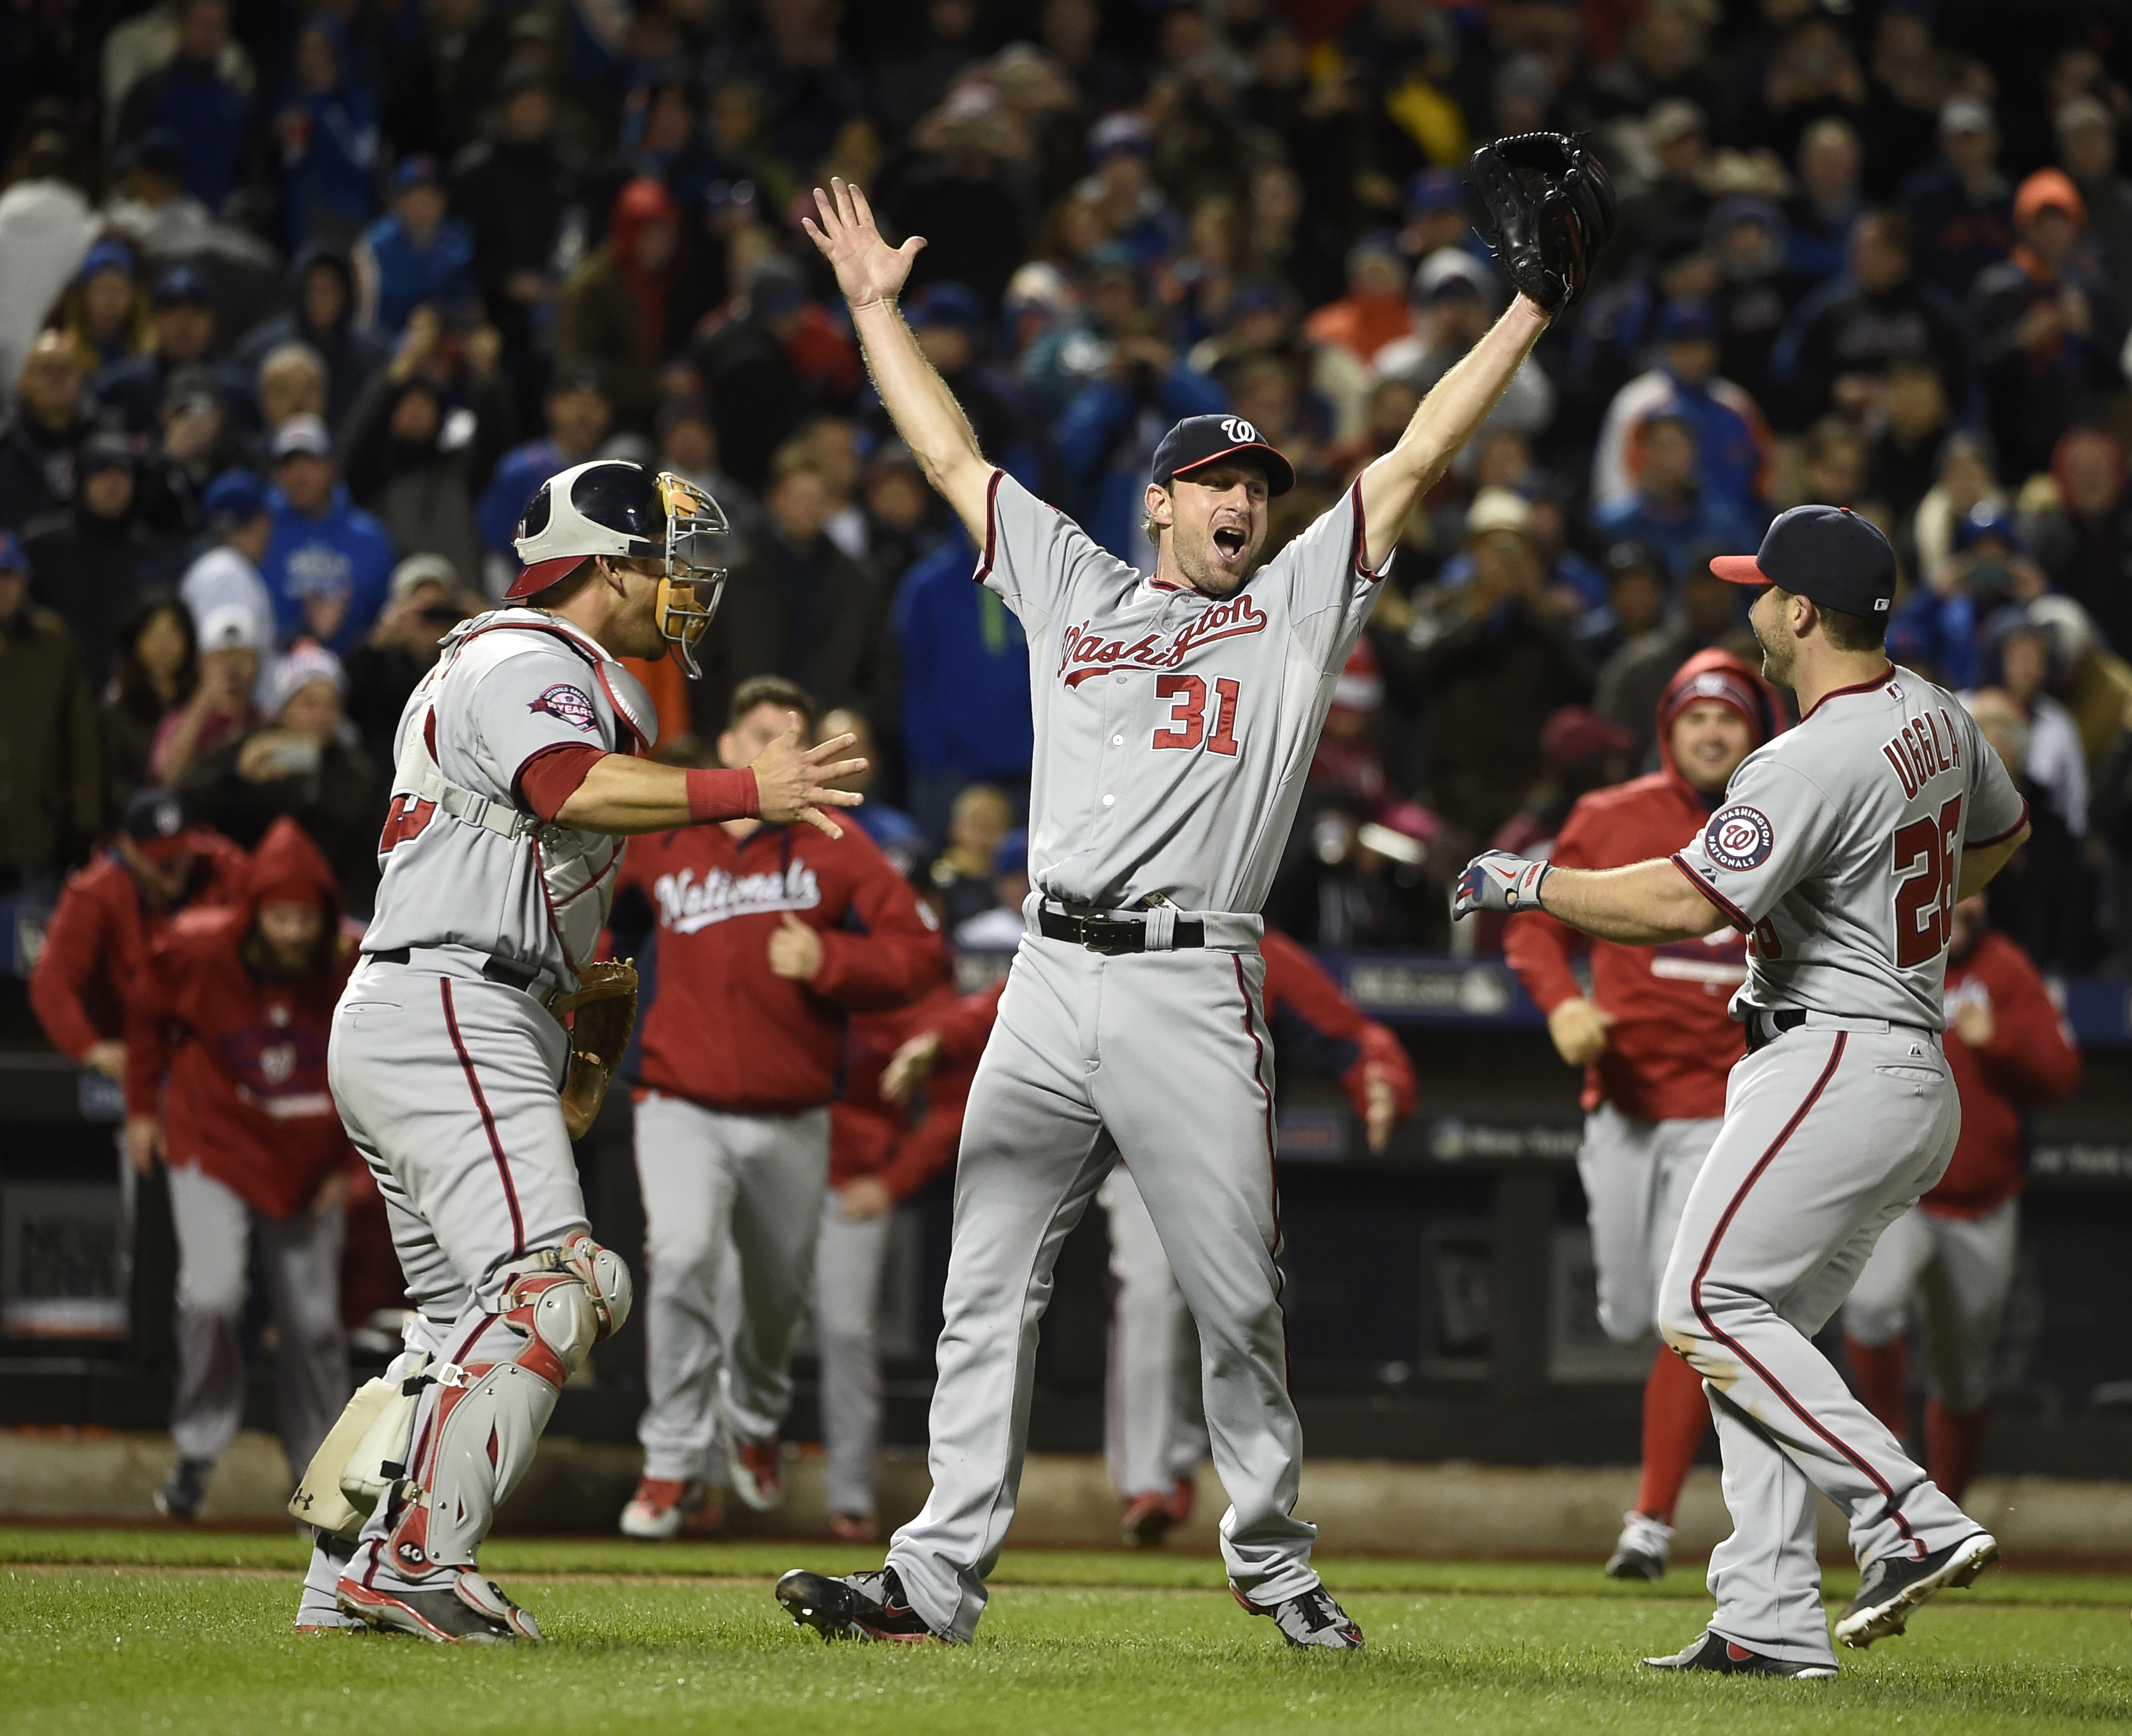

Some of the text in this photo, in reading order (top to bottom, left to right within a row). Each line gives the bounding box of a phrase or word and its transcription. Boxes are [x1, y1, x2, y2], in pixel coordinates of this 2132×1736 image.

[1221, 419, 1255, 443] W
[1057, 594, 1267, 691] Washigton
[557, 703, 594, 719] YEARS
[1150, 674, 1242, 759] 31
[1880, 706, 1961, 802] UGGLA
[1718, 808, 1770, 847] WASHINGTON
[1723, 824, 1756, 850] W
[1708, 835, 1755, 867] NATIONALS
[1892, 789, 1963, 969] 26
[399, 1543, 424, 1561] 40
